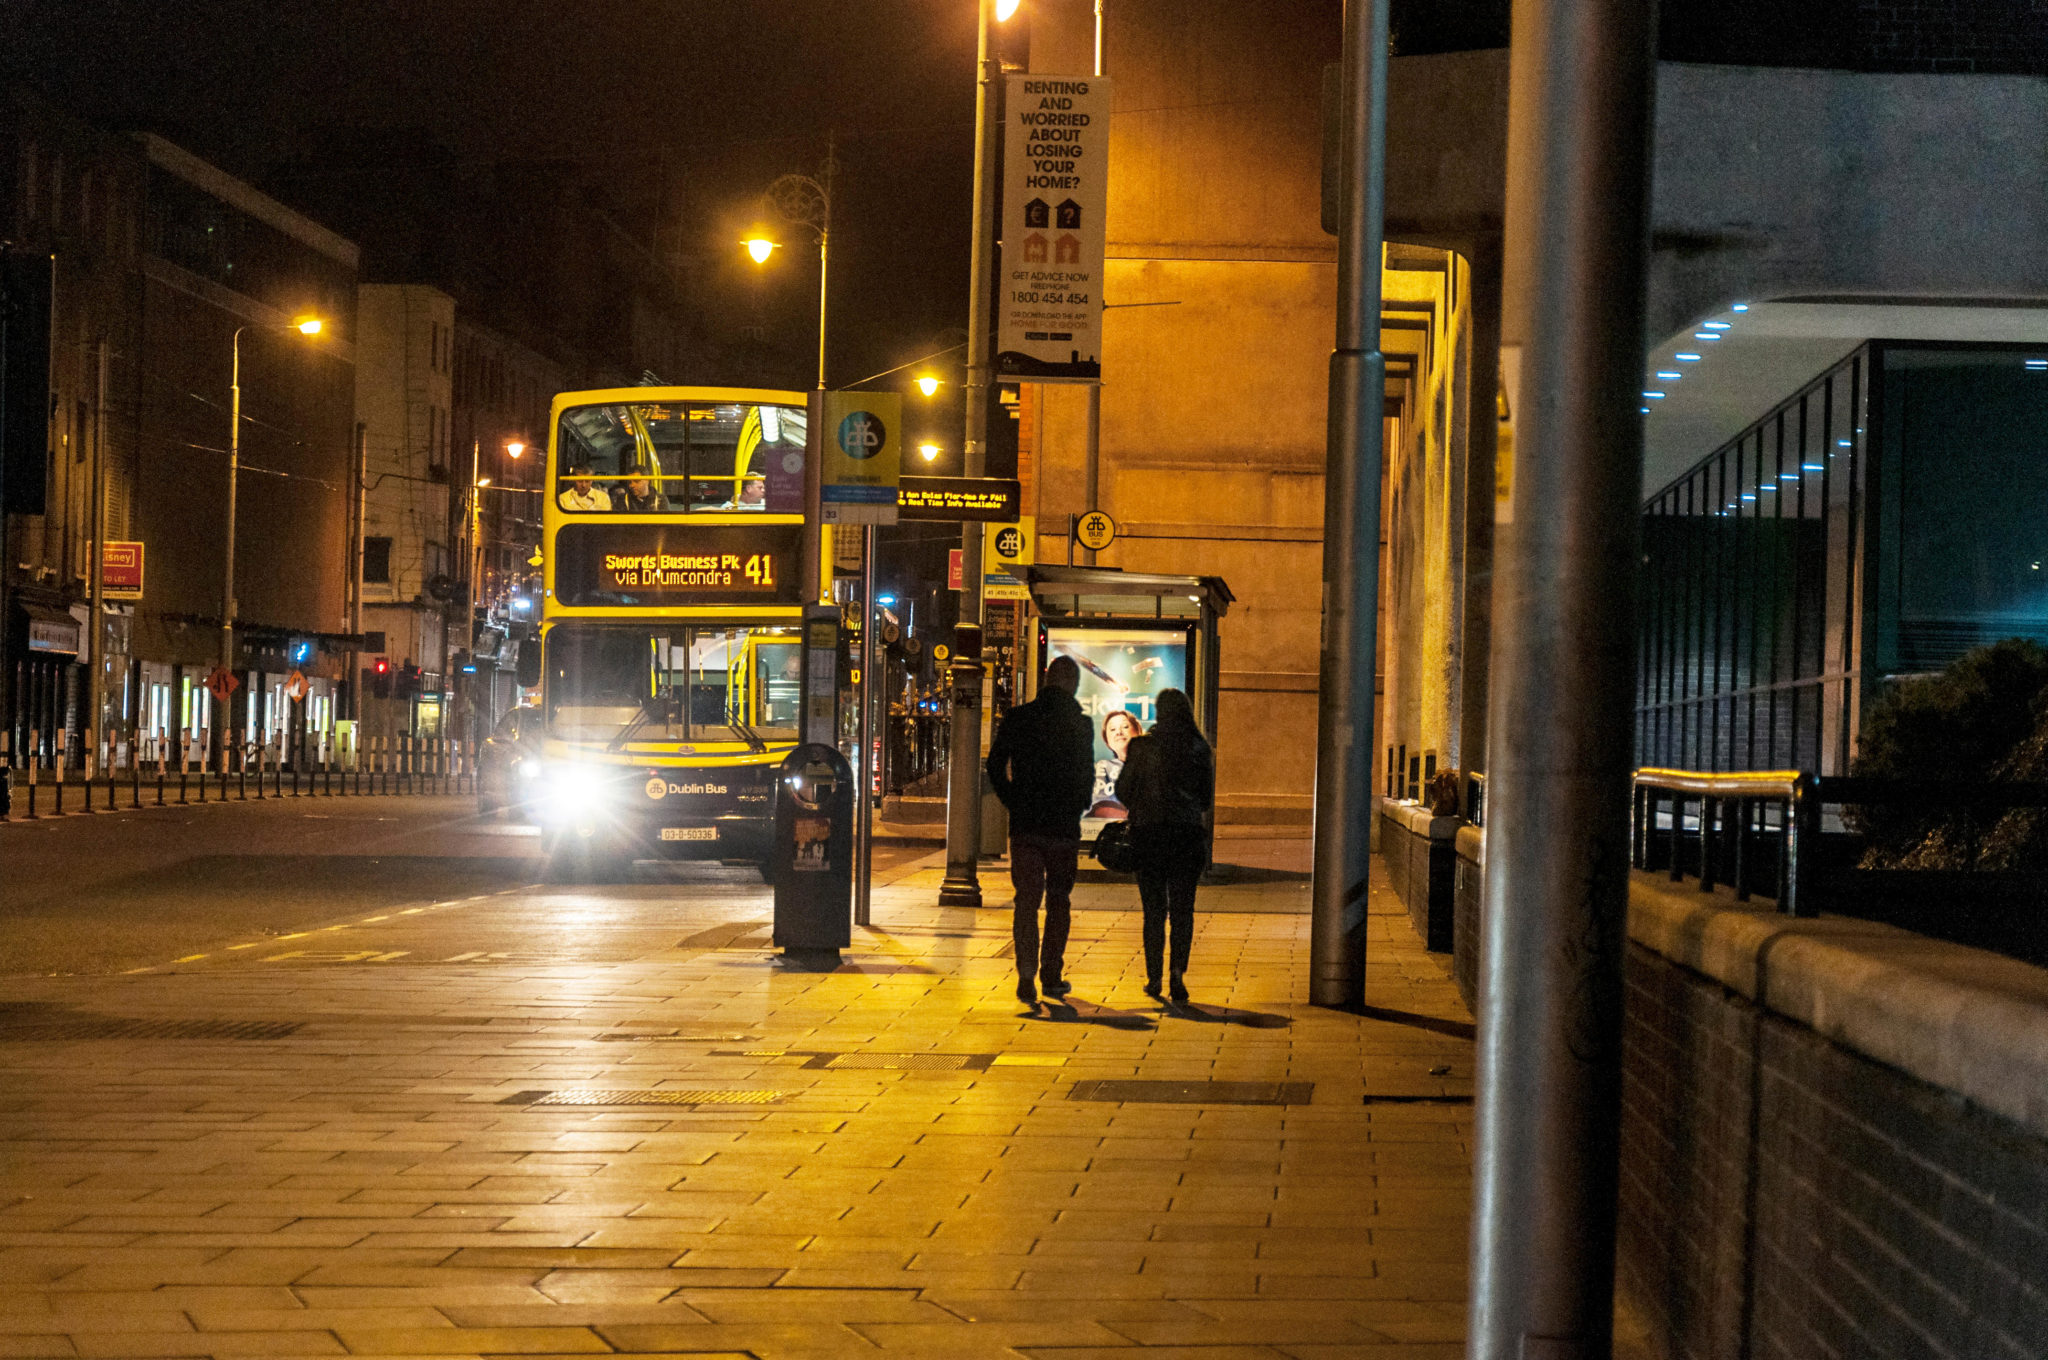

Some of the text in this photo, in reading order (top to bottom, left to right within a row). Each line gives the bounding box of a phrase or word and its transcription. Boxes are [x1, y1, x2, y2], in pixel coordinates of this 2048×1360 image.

[1024, 81, 1088, 95] RENTING
[1039, 97, 1073, 110] AND
[1021, 112, 1090, 126] WORRIED
[1029, 128, 1081, 142] ABOUT
[1026, 143, 1083, 158] LOSING
[1033, 159, 1075, 173] YOUR
[1026, 175, 1080, 189] HOME?
[1012, 271, 1089, 282] GET ADVICE NOW
[1012, 291, 1088, 305] 1800 454 454
[947, 499, 963, 507] Info
[104, 552, 131, 564] isney
[606, 555, 740, 569] Swords Business Pk
[615, 569, 731, 585] via Drumcondra
[745, 555, 773, 585] 41
[669, 783, 727, 794] Dublin Bus
